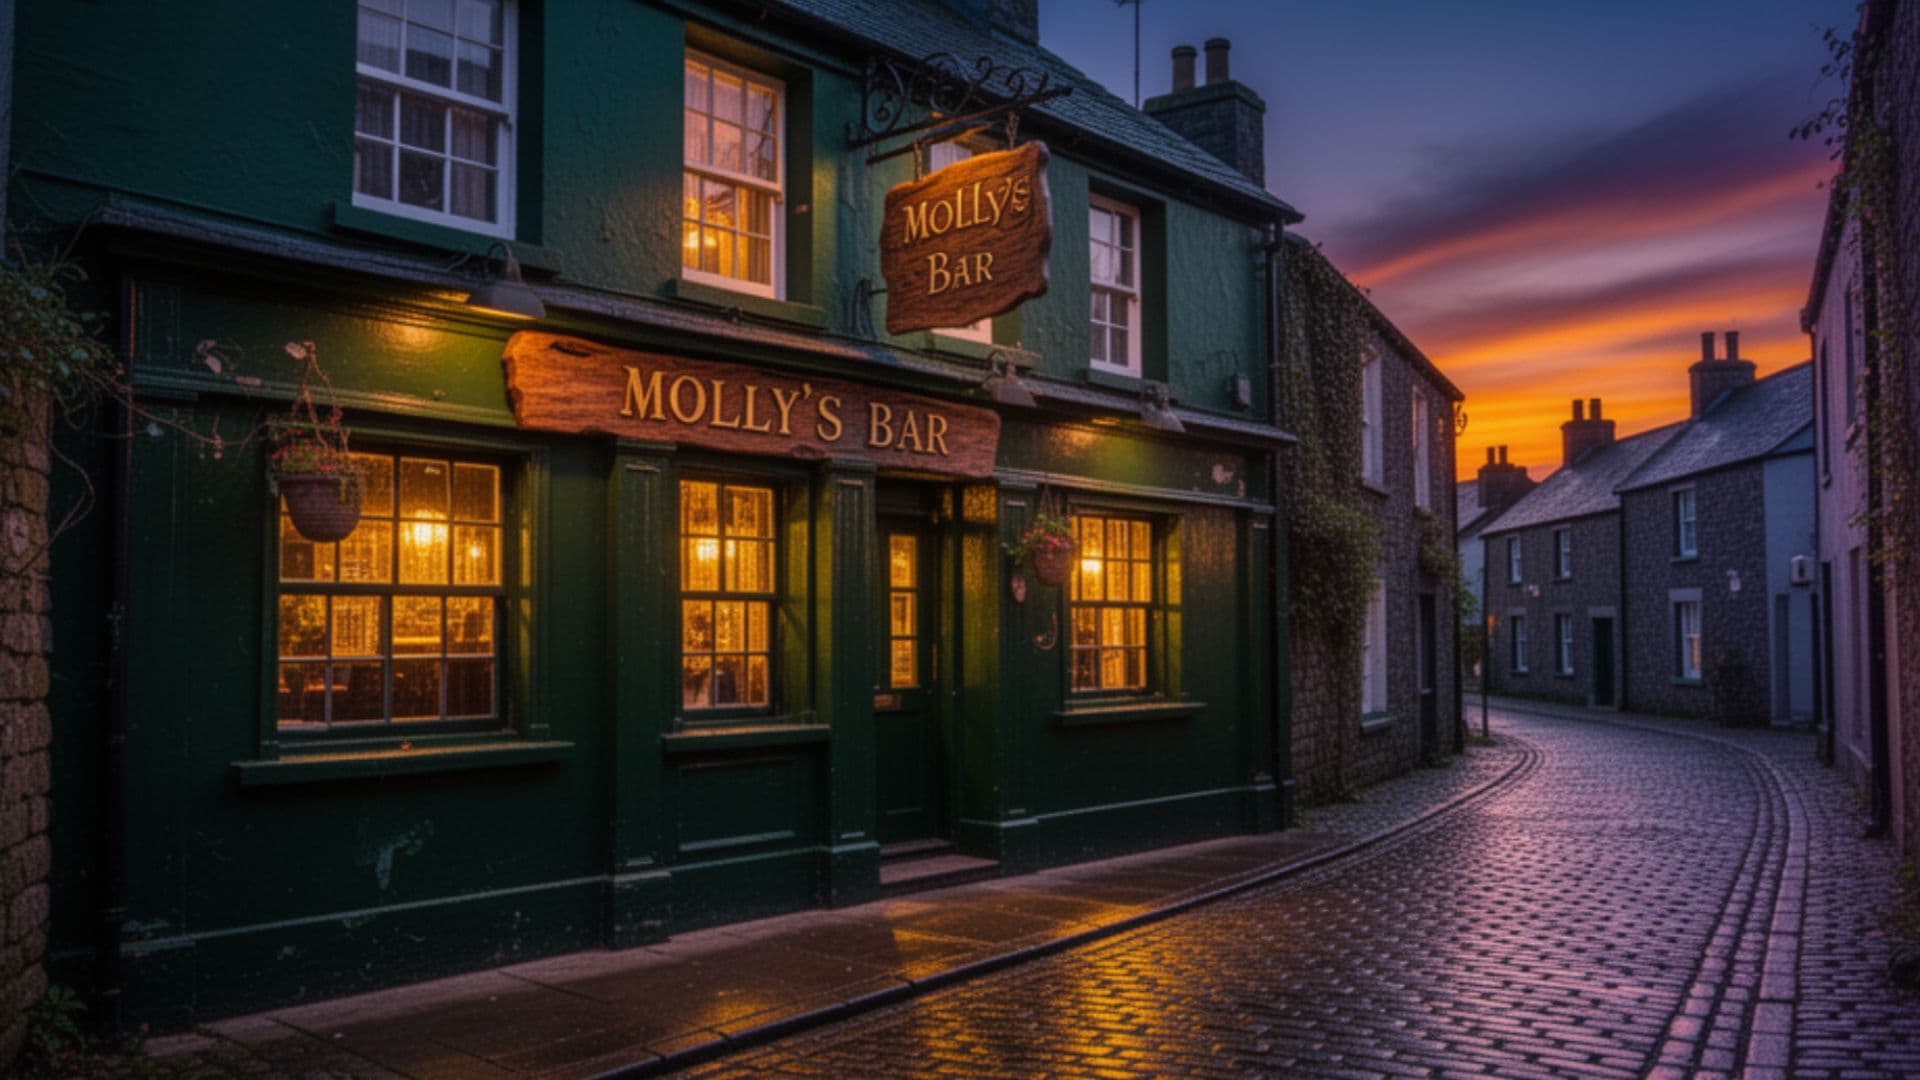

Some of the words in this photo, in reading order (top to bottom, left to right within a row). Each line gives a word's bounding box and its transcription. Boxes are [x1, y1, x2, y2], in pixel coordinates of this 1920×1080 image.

[928, 252, 993, 295] BAR
[621, 366, 842, 442] MOLLY'S
[869, 402, 949, 455] BAR
